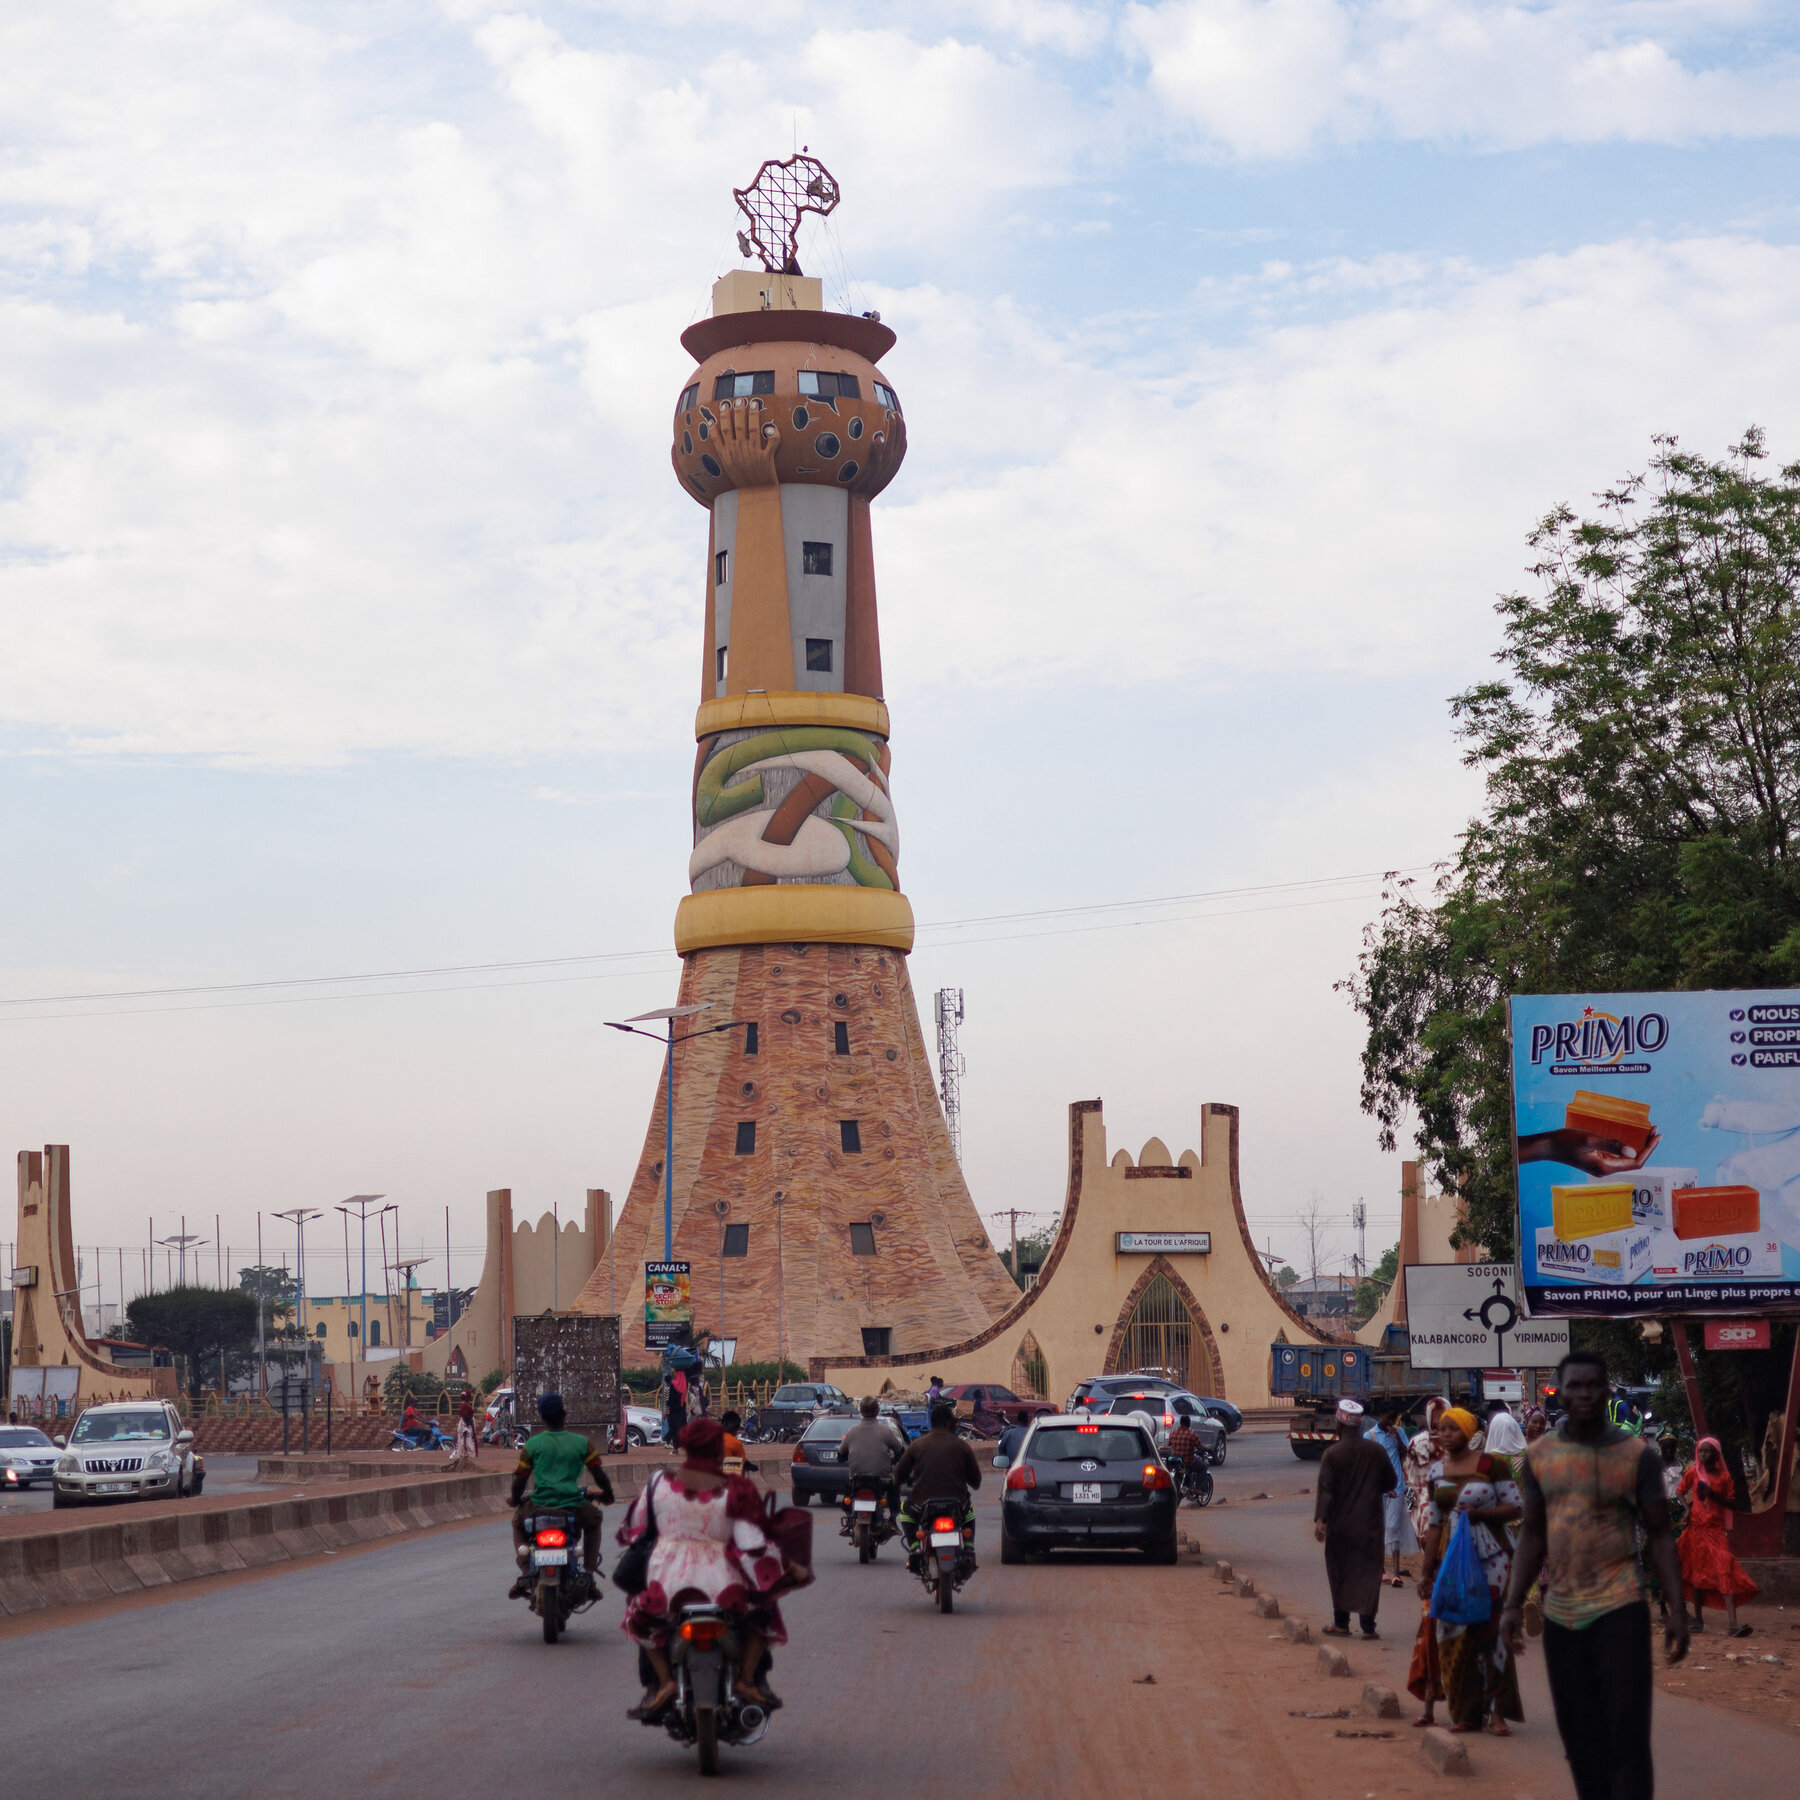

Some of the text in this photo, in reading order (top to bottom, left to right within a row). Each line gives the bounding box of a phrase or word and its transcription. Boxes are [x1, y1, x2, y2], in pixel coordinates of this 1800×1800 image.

[1753, 1008, 1800, 1020] MOUS
[1530, 1013, 1669, 1065] PRIMO
[1580, 1065, 1617, 1073] Meilleure
[1619, 1063, 1648, 1072] Qualité
[1766, 1242, 1777, 1251] 36
[1538, 1244, 1591, 1262] PRIMO
[1684, 1246, 1751, 1272] PRIMO
[648, 1264, 688, 1272] CANAL+
[1544, 1291, 1581, 1300] Savon
[1584, 1290, 1631, 1301] PRIMO,
[1634, 1290, 1663, 1301] pour
[1667, 1290, 1682, 1298] un
[1685, 1288, 1718, 1300] Linge
[1721, 1288, 1746, 1300] plus
[1749, 1288, 1791, 1300] propre
[1411, 1333, 1487, 1344] KALABANCORO
[1514, 1332, 1568, 1343] YIRIMADIO
[1082, 1483, 1092, 1493] CE
